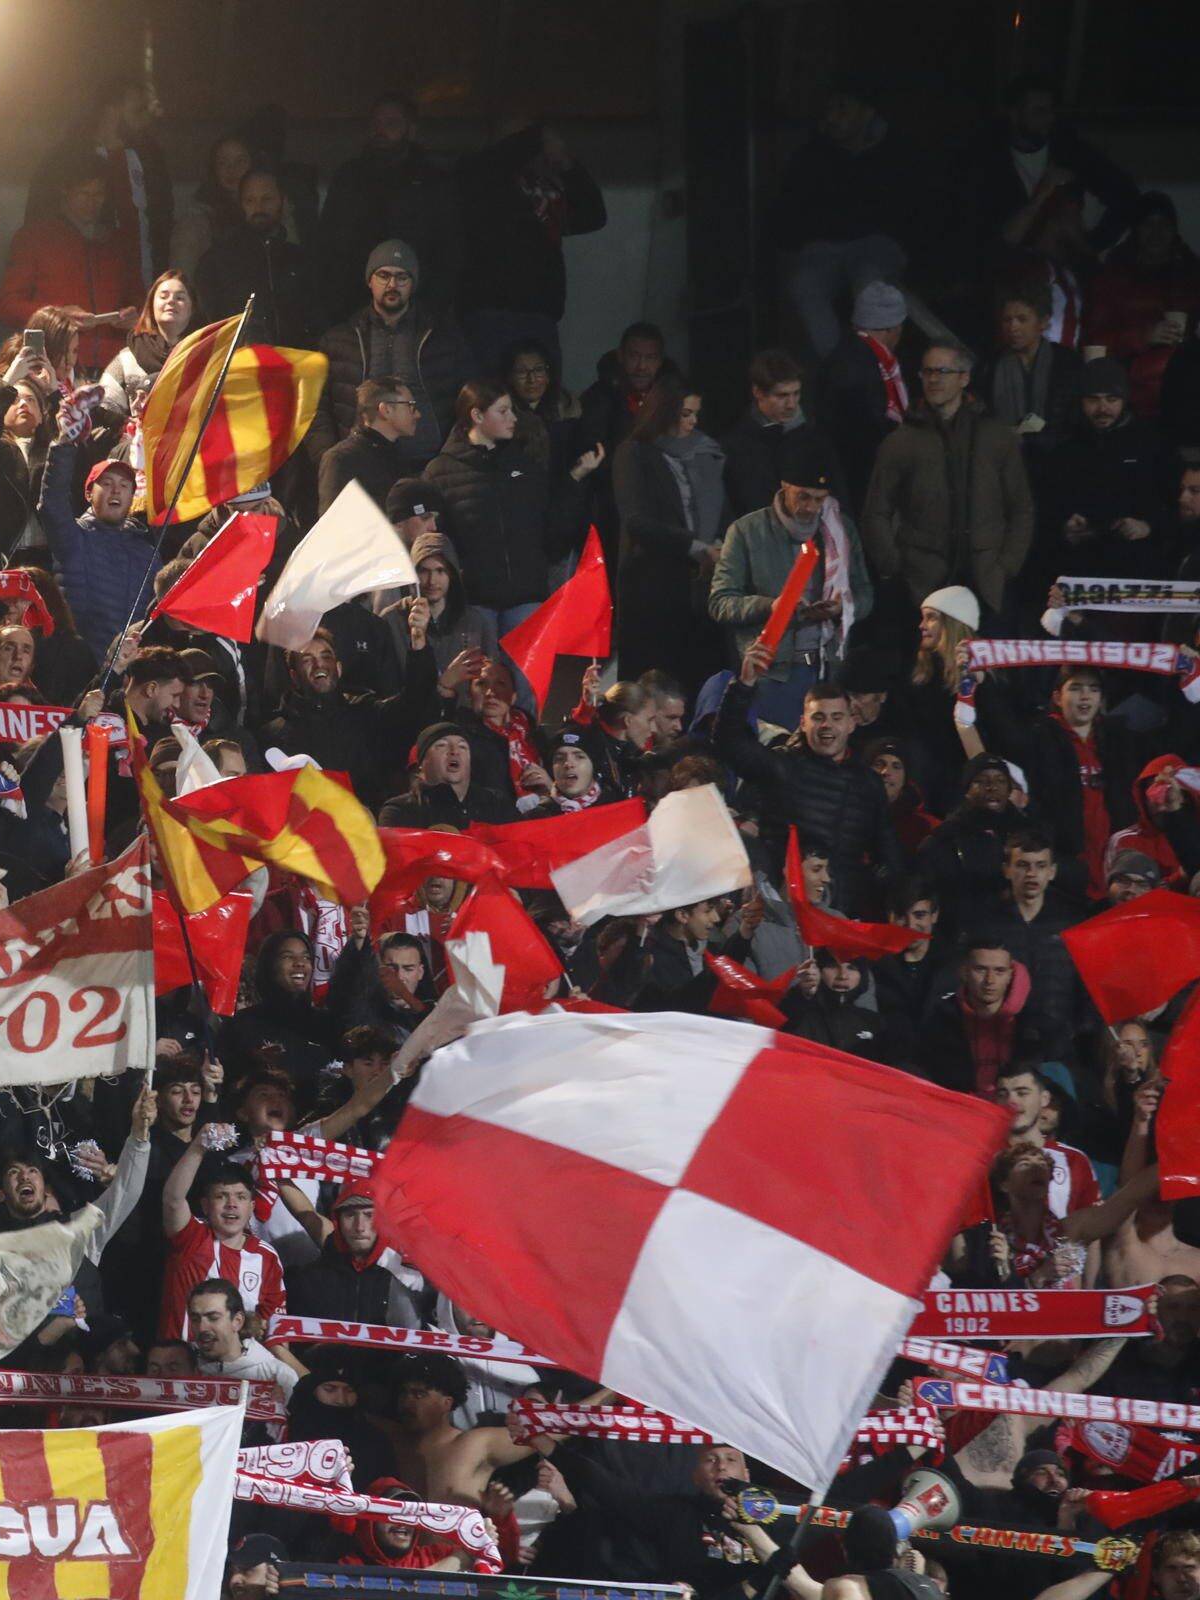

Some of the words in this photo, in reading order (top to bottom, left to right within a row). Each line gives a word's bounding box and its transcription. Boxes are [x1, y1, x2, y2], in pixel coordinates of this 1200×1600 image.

[936, 1293, 1041, 1312] CANNES
[945, 1317, 991, 1333] 1902
[273, 1318, 495, 1353] ANNES
